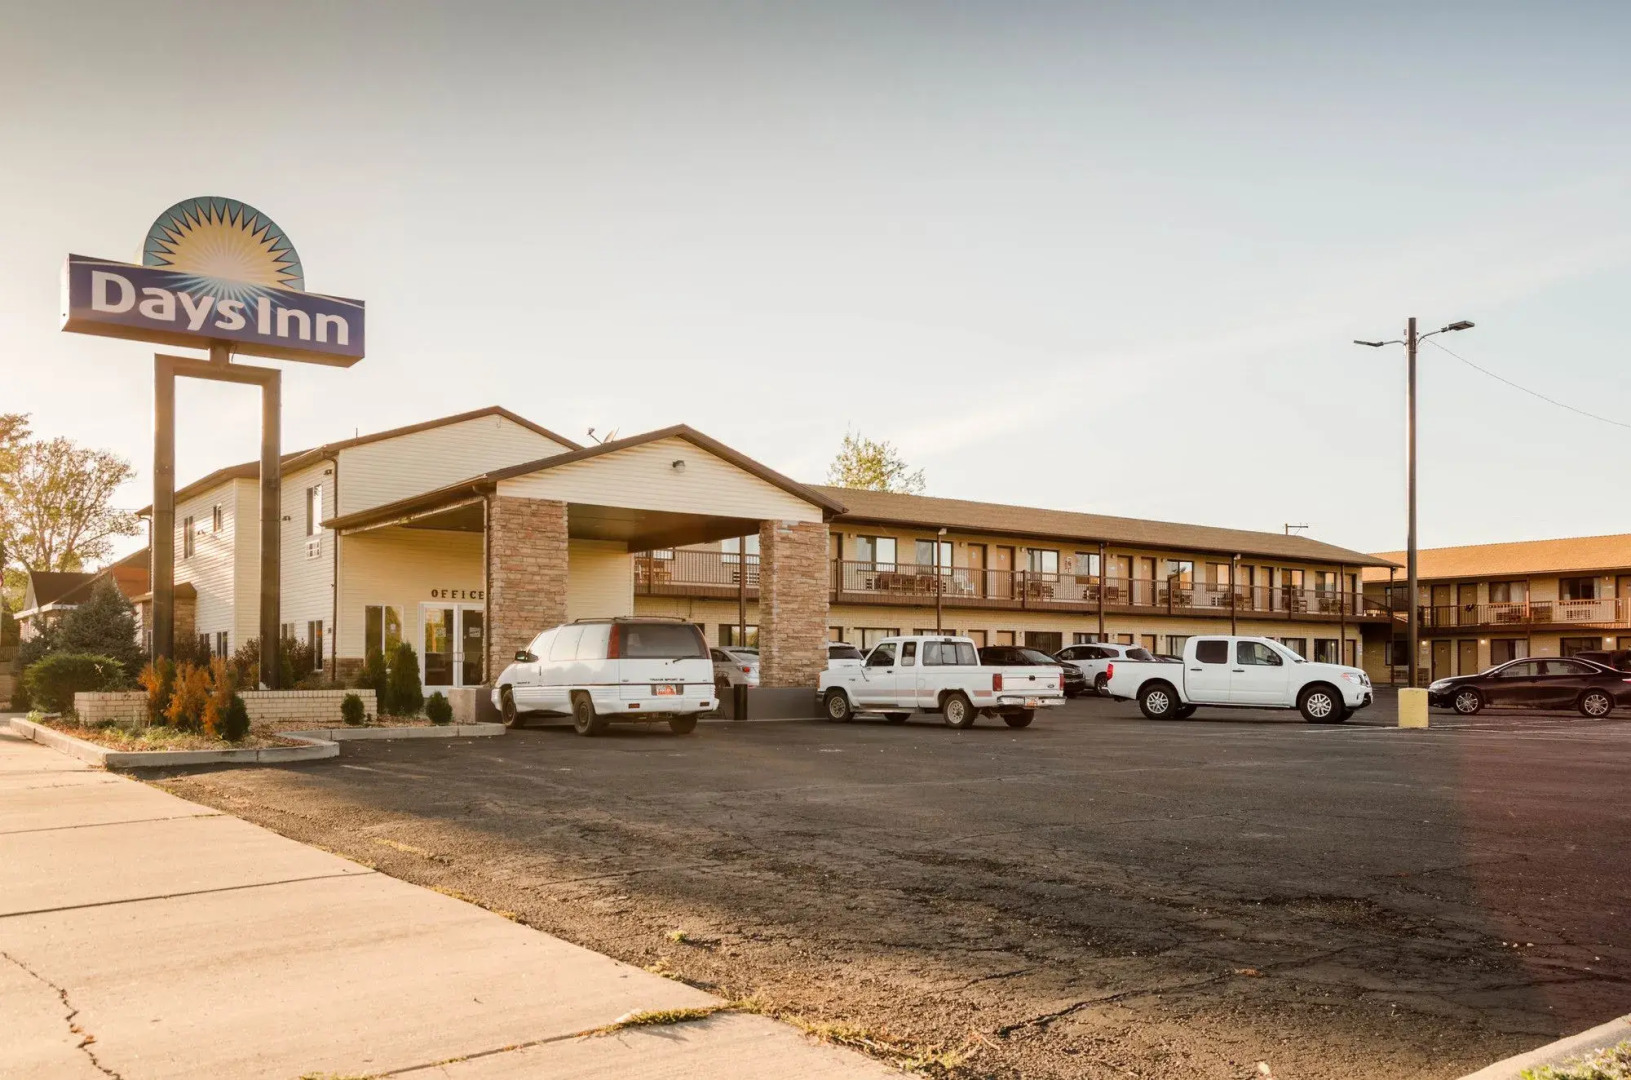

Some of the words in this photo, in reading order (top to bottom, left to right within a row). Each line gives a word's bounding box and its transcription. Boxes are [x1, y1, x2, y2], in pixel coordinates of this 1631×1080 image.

[91, 270, 246, 331] Days
[257, 296, 349, 346] Inn
[431, 589, 485, 600] OFFICE
